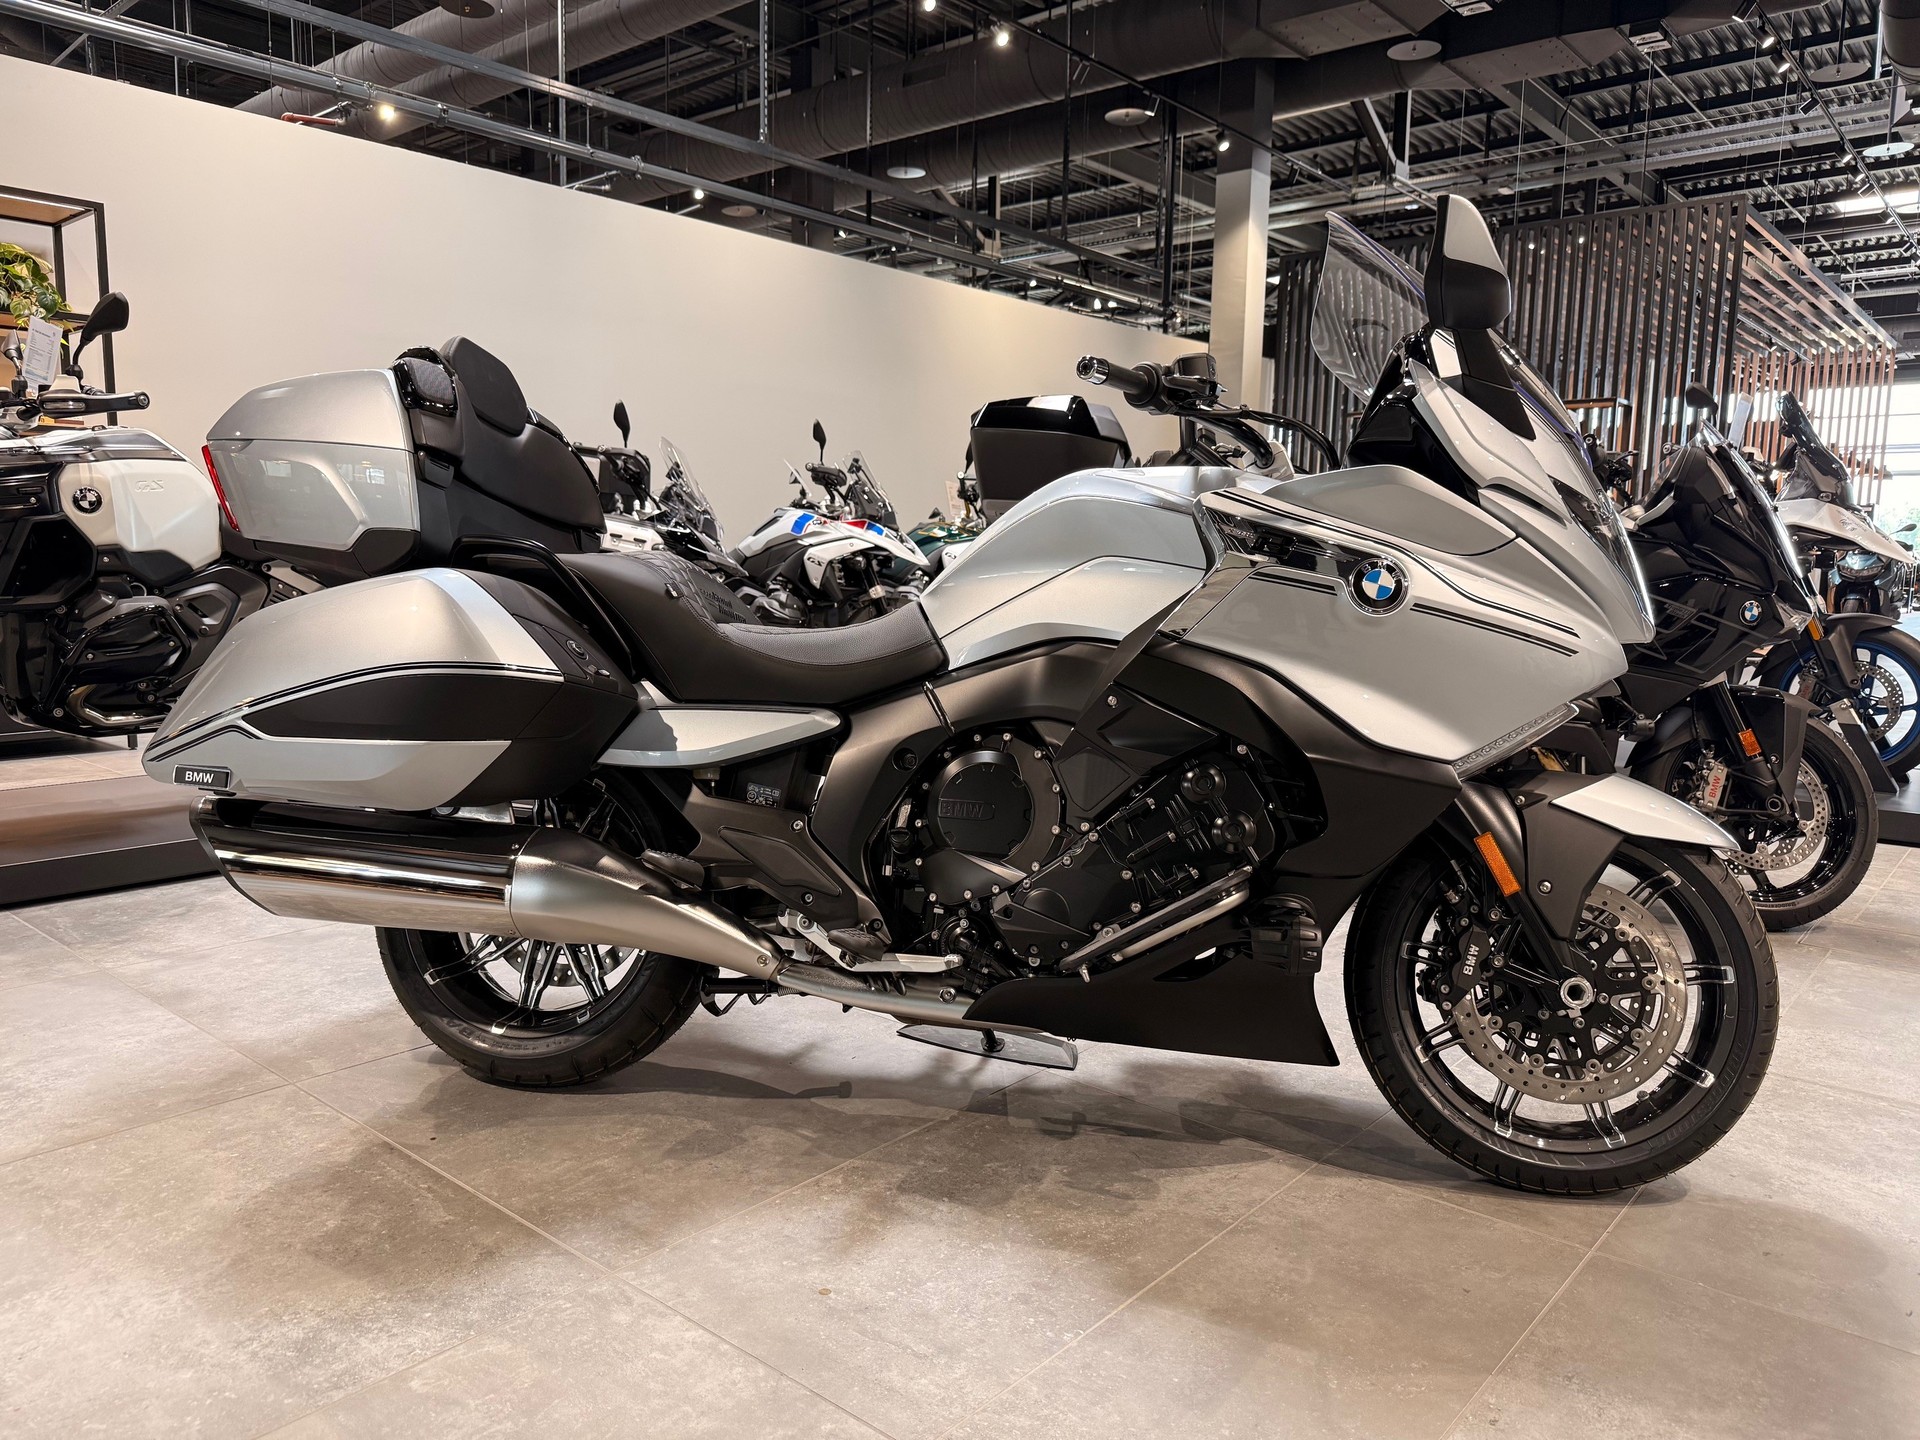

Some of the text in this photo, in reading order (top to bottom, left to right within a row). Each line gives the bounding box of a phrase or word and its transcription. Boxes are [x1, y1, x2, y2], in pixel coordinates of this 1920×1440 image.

[1361, 560, 1402, 580] BMW
[185, 771, 214, 784] BMW
[1709, 775, 1721, 798] BMW
[942, 802, 984, 818] BMW
[1463, 944, 1479, 975] BMW
